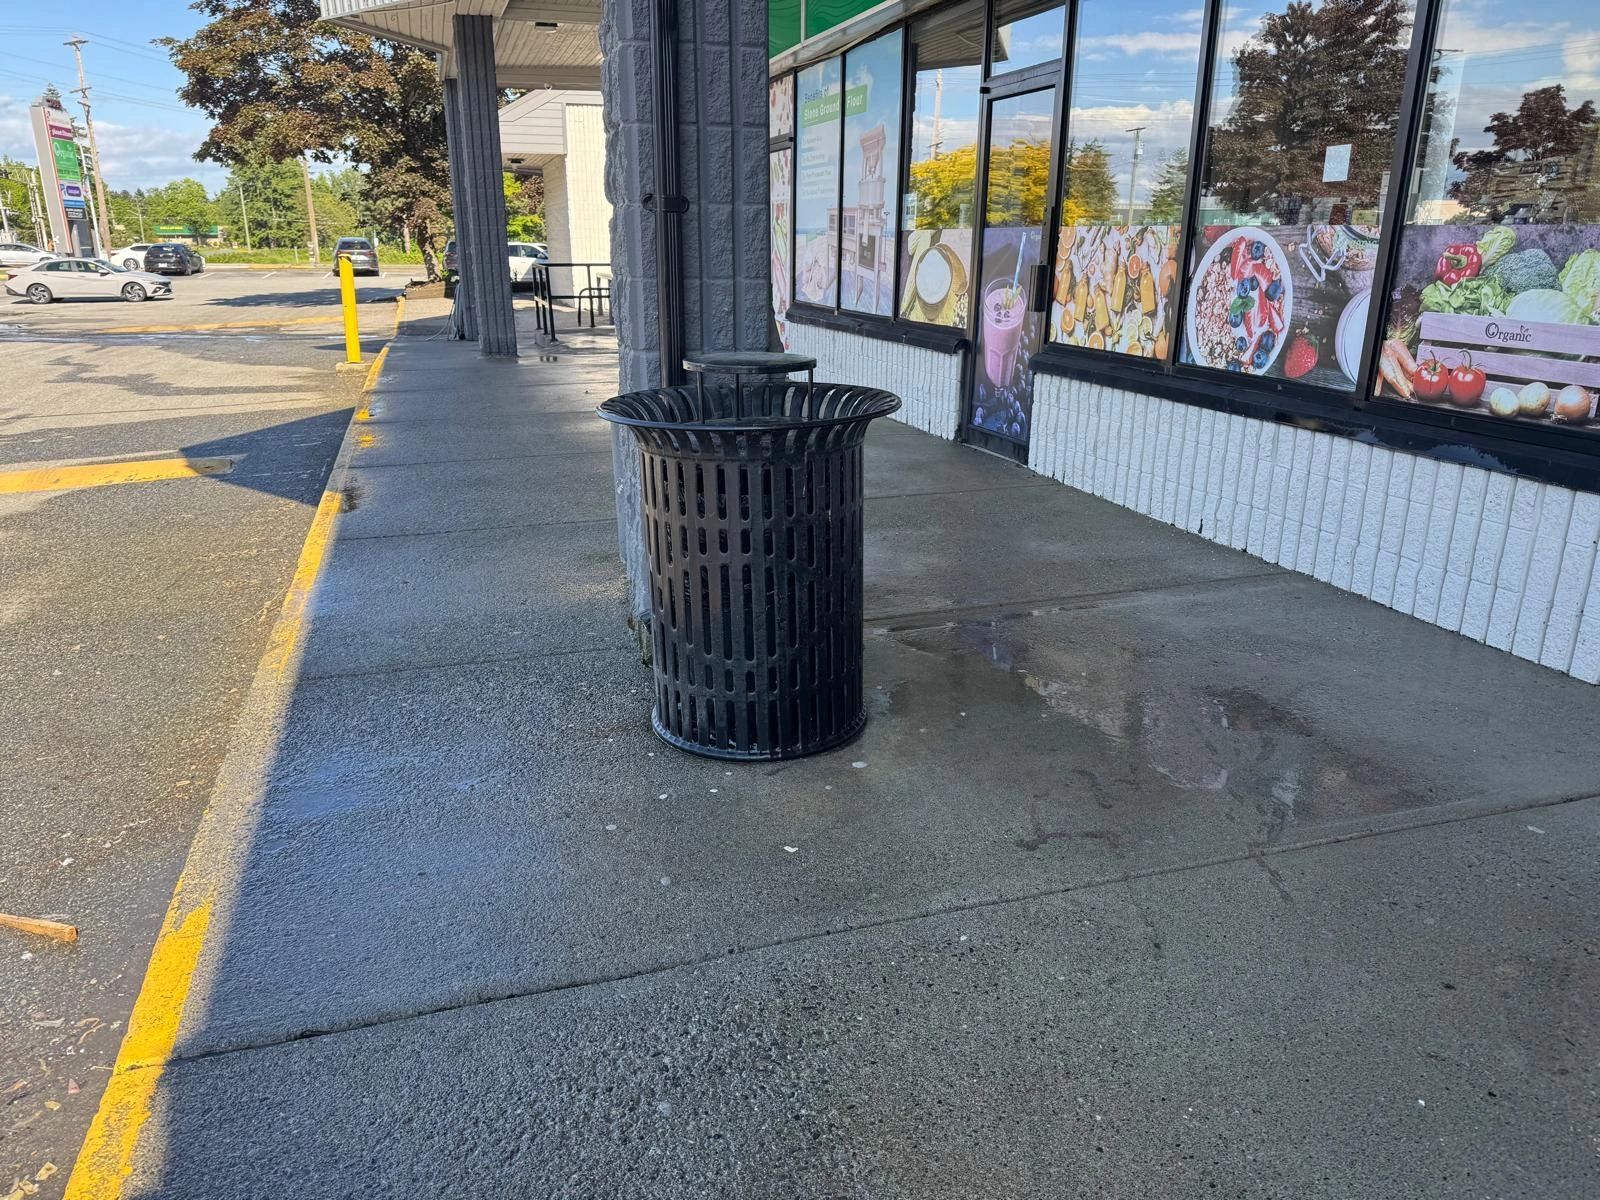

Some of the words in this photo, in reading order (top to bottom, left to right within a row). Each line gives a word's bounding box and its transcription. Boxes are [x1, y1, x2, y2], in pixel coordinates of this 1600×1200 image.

[804, 107, 818, 121] Stone
[819, 98, 839, 116] Ground
[846, 95, 863, 108] Flour
[1485, 322, 1532, 343] Organic
